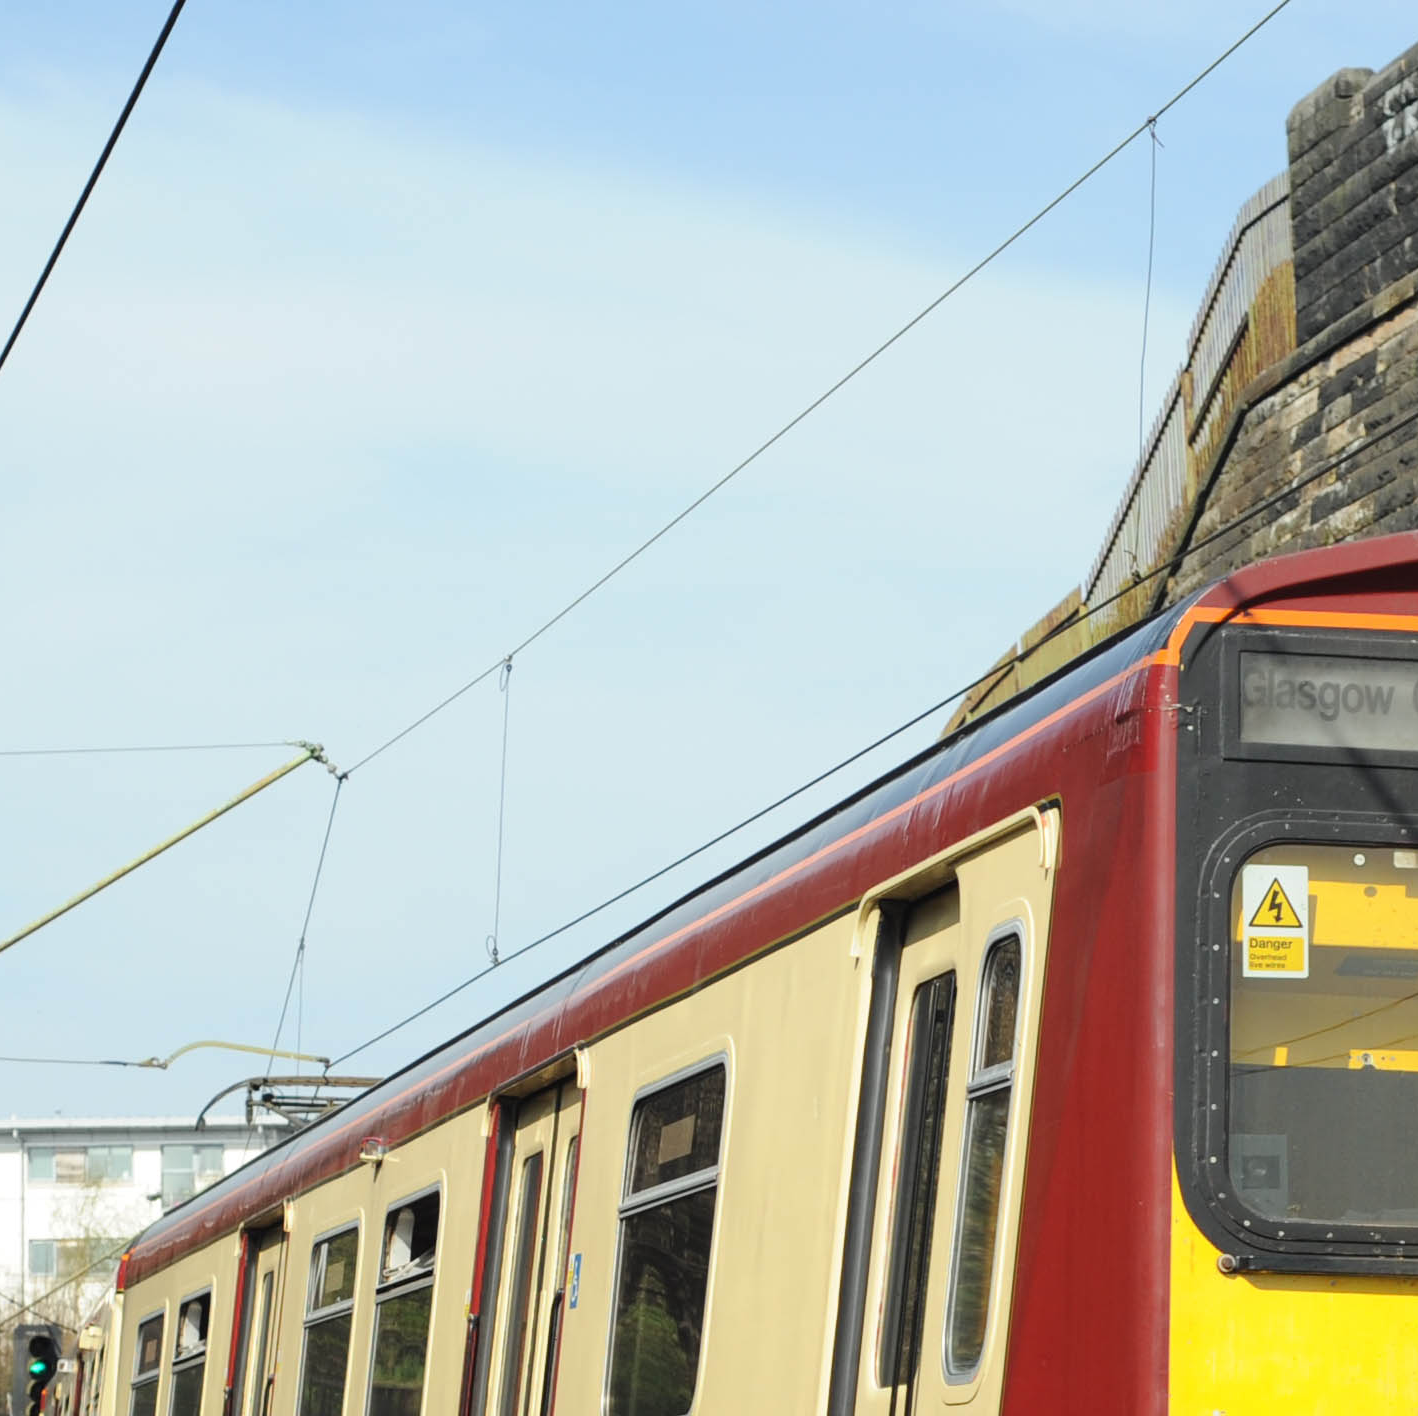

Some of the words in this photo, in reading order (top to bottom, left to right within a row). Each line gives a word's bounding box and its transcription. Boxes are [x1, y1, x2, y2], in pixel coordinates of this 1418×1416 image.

[1241, 667, 1395, 722] Glasgow
[1249, 937, 1294, 951] Danger
[1249, 953, 1288, 961] Overhead
